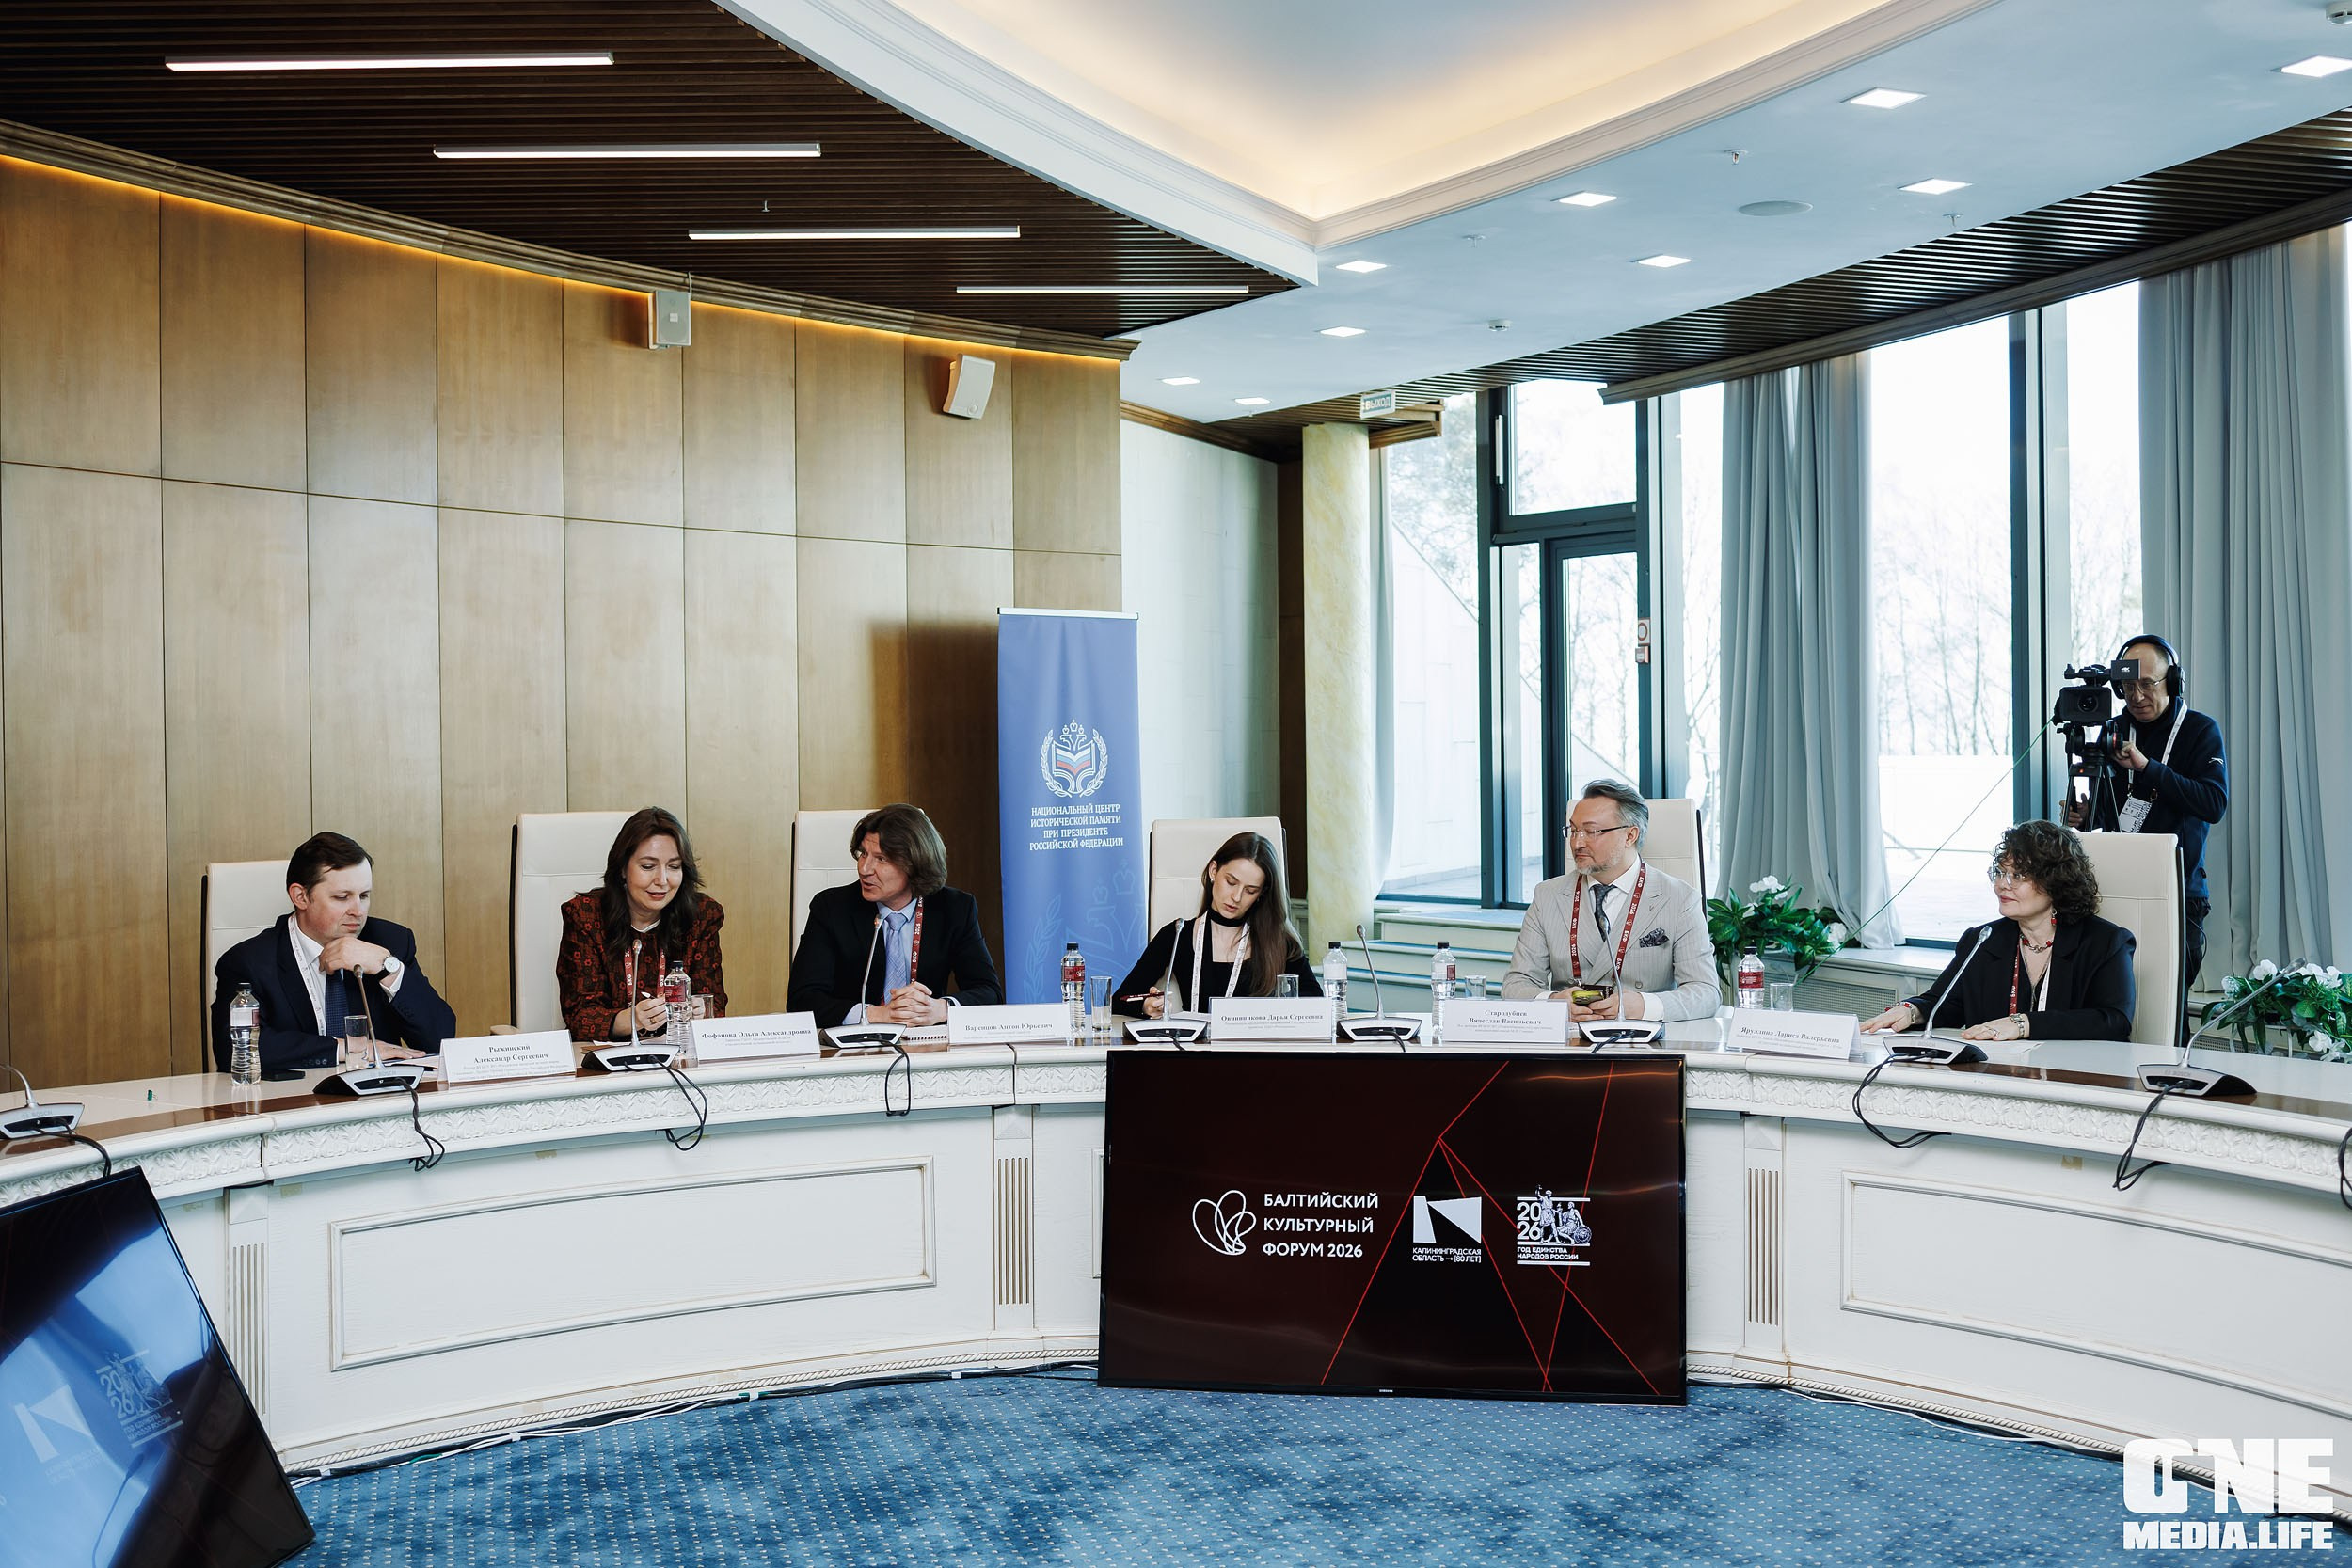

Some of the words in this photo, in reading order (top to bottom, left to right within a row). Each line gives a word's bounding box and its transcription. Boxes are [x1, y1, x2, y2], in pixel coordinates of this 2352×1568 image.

[1365, 396, 1391, 410] ВЫХОД
[1031, 803, 1093, 816] НАЦИОНАЛЬНЫЙ
[1095, 803, 1120, 814] ЦЕНТР
[1030, 815, 1089, 828] ИСТОРИЧЕСКОЙ
[1089, 815, 1121, 825] ПАМЯТИ
[1043, 829, 1058, 839] ПРИ
[1060, 827, 1108, 837] ПРЕЗИДЕНТЕ
[1029, 838, 1078, 851] РОССИЙСКОЙ
[1079, 837, 1124, 848] ФЕДЕРАЦИИ
[1774, 1030, 1799, 1039] Лариса
[1801, 1033, 1840, 1044] Валерьевна
[473, 1054, 511, 1064] Александр
[512, 1053, 548, 1062] Сергеевич
[1263, 1191, 1378, 1209] БАЛТИЙСКИЙ
[1517, 1202, 1540, 1221] 20
[1263, 1217, 1374, 1233] КУЛЬТУРНЫЙ
[1517, 1221, 1541, 1240] 26
[1263, 1242, 1324, 1257] ФОРУМ
[1327, 1243, 1363, 1258] 2026
[1412, 1247, 1482, 1256] КАЛИНИНГРАДСКАЯ
[1412, 1254, 1445, 1262] ОБЛАСТЬ
[100, 1370, 125, 1397] 20
[110, 1392, 135, 1418] 26
